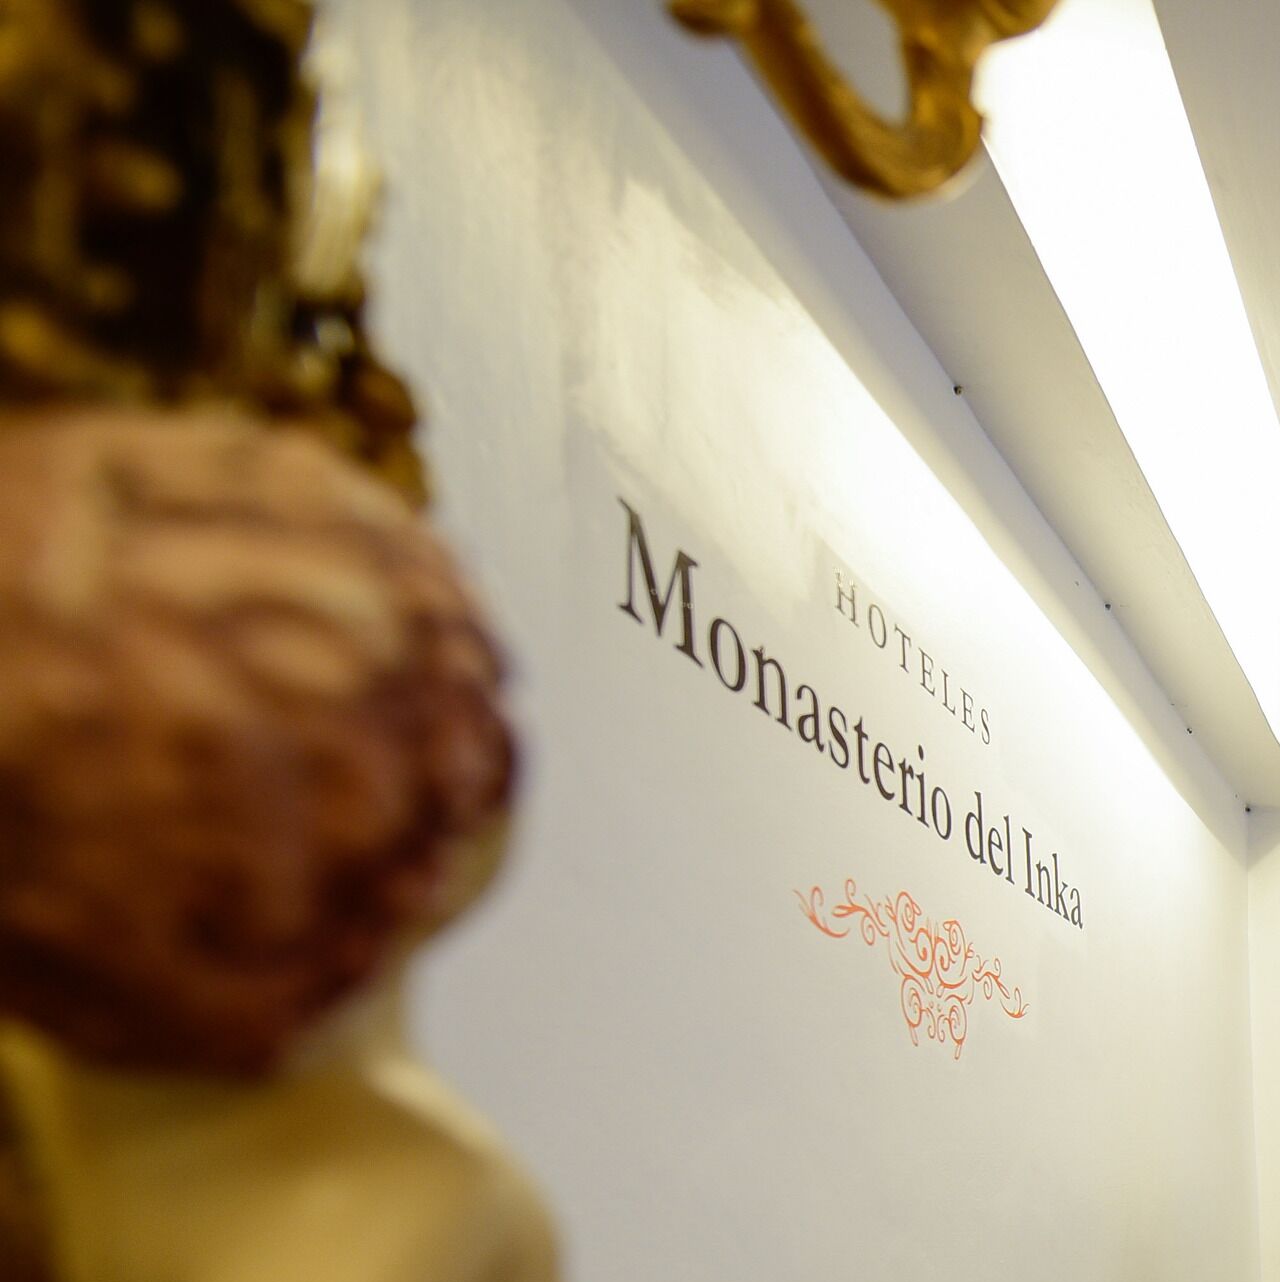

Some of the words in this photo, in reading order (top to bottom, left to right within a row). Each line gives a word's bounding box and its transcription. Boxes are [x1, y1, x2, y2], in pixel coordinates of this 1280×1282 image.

[616, 496, 953, 842] Monasterio
[965, 791, 1015, 886] del
[1022, 827, 1084, 930] Inka
[833, 568, 991, 746] HOTELES
